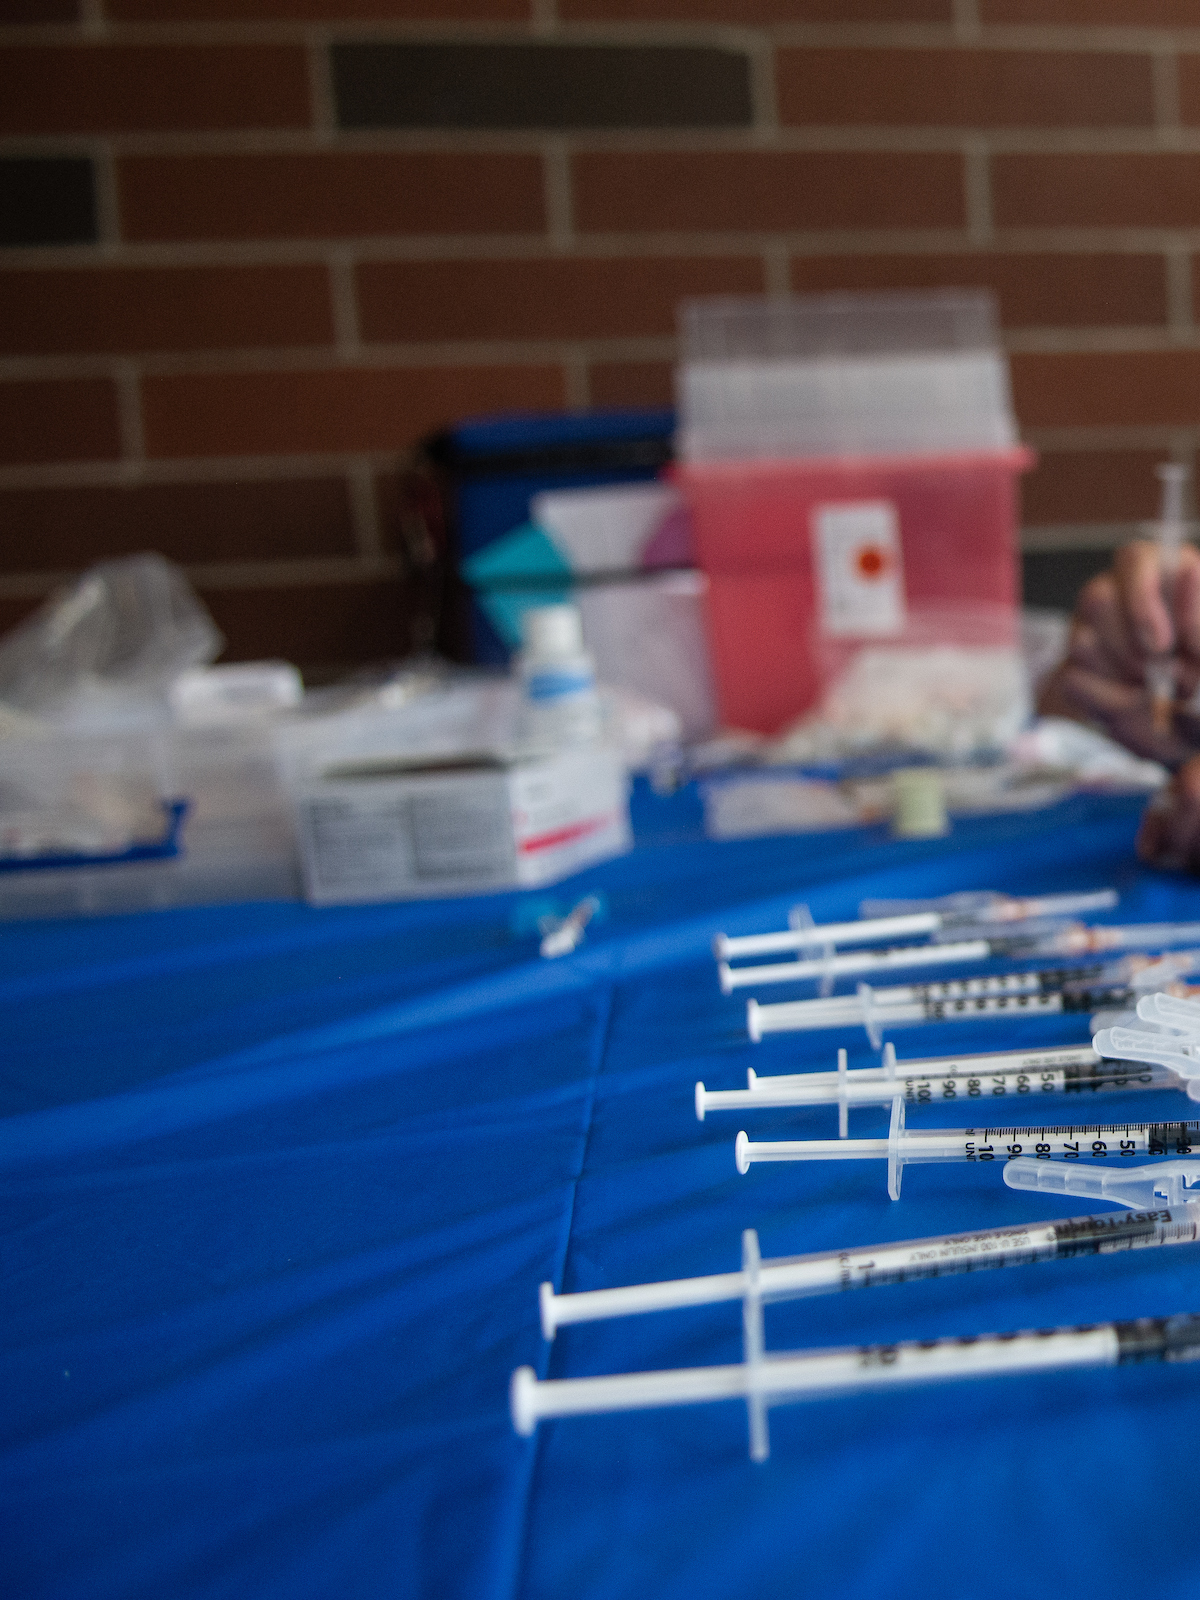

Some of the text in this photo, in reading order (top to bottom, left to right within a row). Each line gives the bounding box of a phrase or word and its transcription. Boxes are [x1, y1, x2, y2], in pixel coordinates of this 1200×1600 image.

[943, 1080, 957, 1099] 90
[967, 1078, 981, 1097] 80
[992, 1076, 1006, 1096] 70
[1017, 1074, 1031, 1094] 60
[1041, 1072, 1055, 1092] 50
[978, 1145, 995, 1161] 10
[1007, 1144, 1022, 1160] 90
[1035, 1143, 1051, 1159] 80
[1063, 1142, 1080, 1159] 70
[1091, 1141, 1107, 1158] 60
[1120, 1140, 1136, 1157] 50
